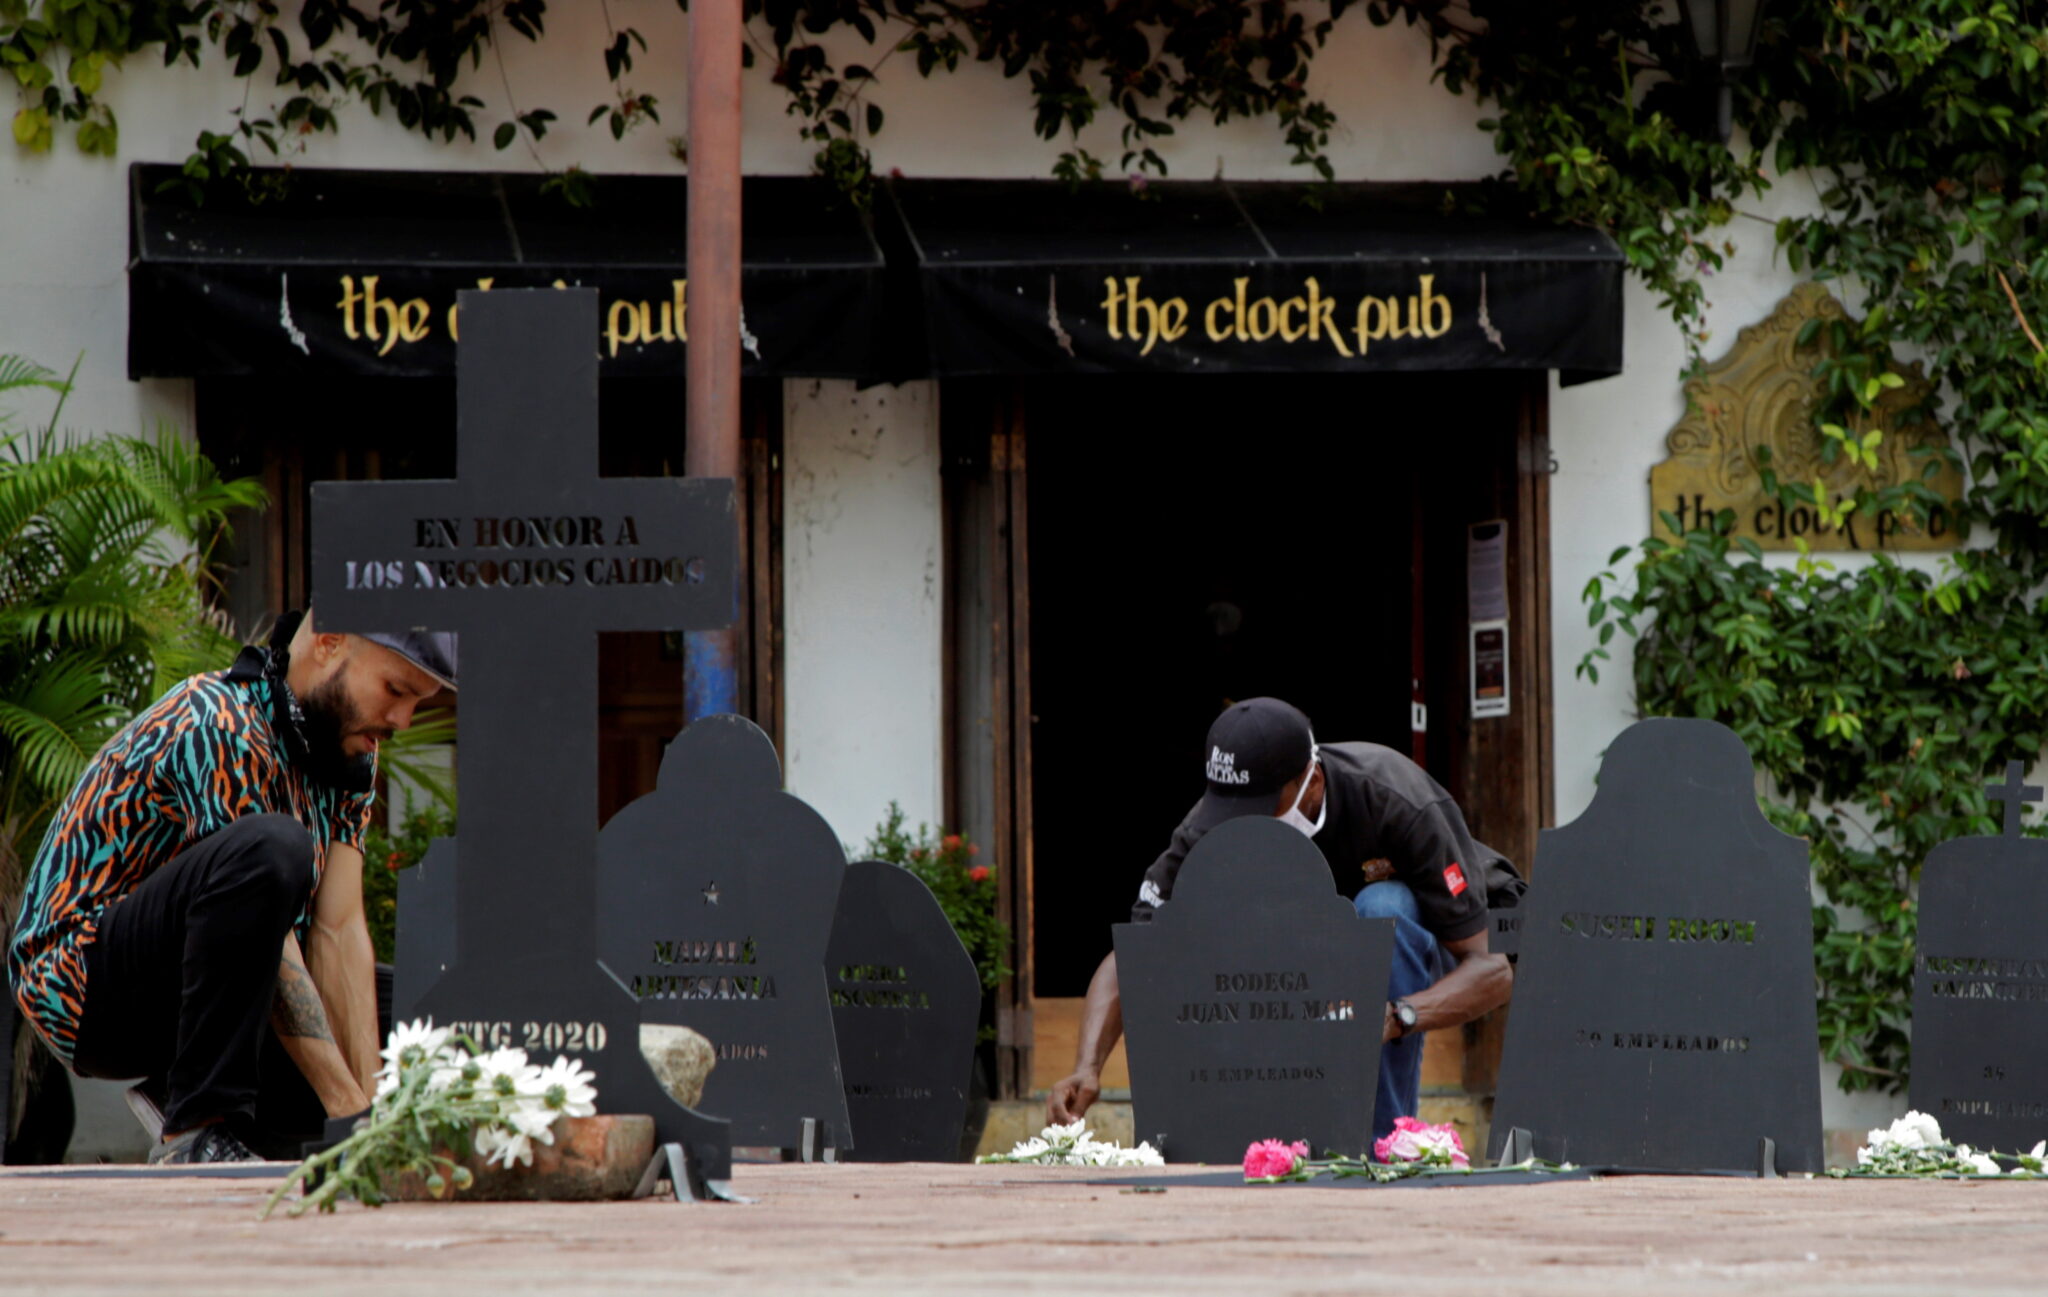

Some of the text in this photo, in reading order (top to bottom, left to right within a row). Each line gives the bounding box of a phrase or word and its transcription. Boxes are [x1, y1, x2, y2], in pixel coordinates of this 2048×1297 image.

[336, 274, 431, 357] the
[1100, 273, 1452, 358] the clock pub
[414, 515, 640, 549] EN HONOR A
[345, 561, 404, 590] LOS
[413, 559, 575, 589] NEGOCIOS
[1560, 912, 1757, 945] SUSHI ROOM
[630, 975, 777, 1001] ARTESANIA
[1214, 972, 1311, 994] BODEGA
[1176, 999, 1356, 1024] JUAN DEL MAR
[522, 1021, 608, 1052] 2020
[1613, 1032, 1750, 1053] EMPLEADOS
[1218, 1066, 1325, 1083] EMPLEADOS
